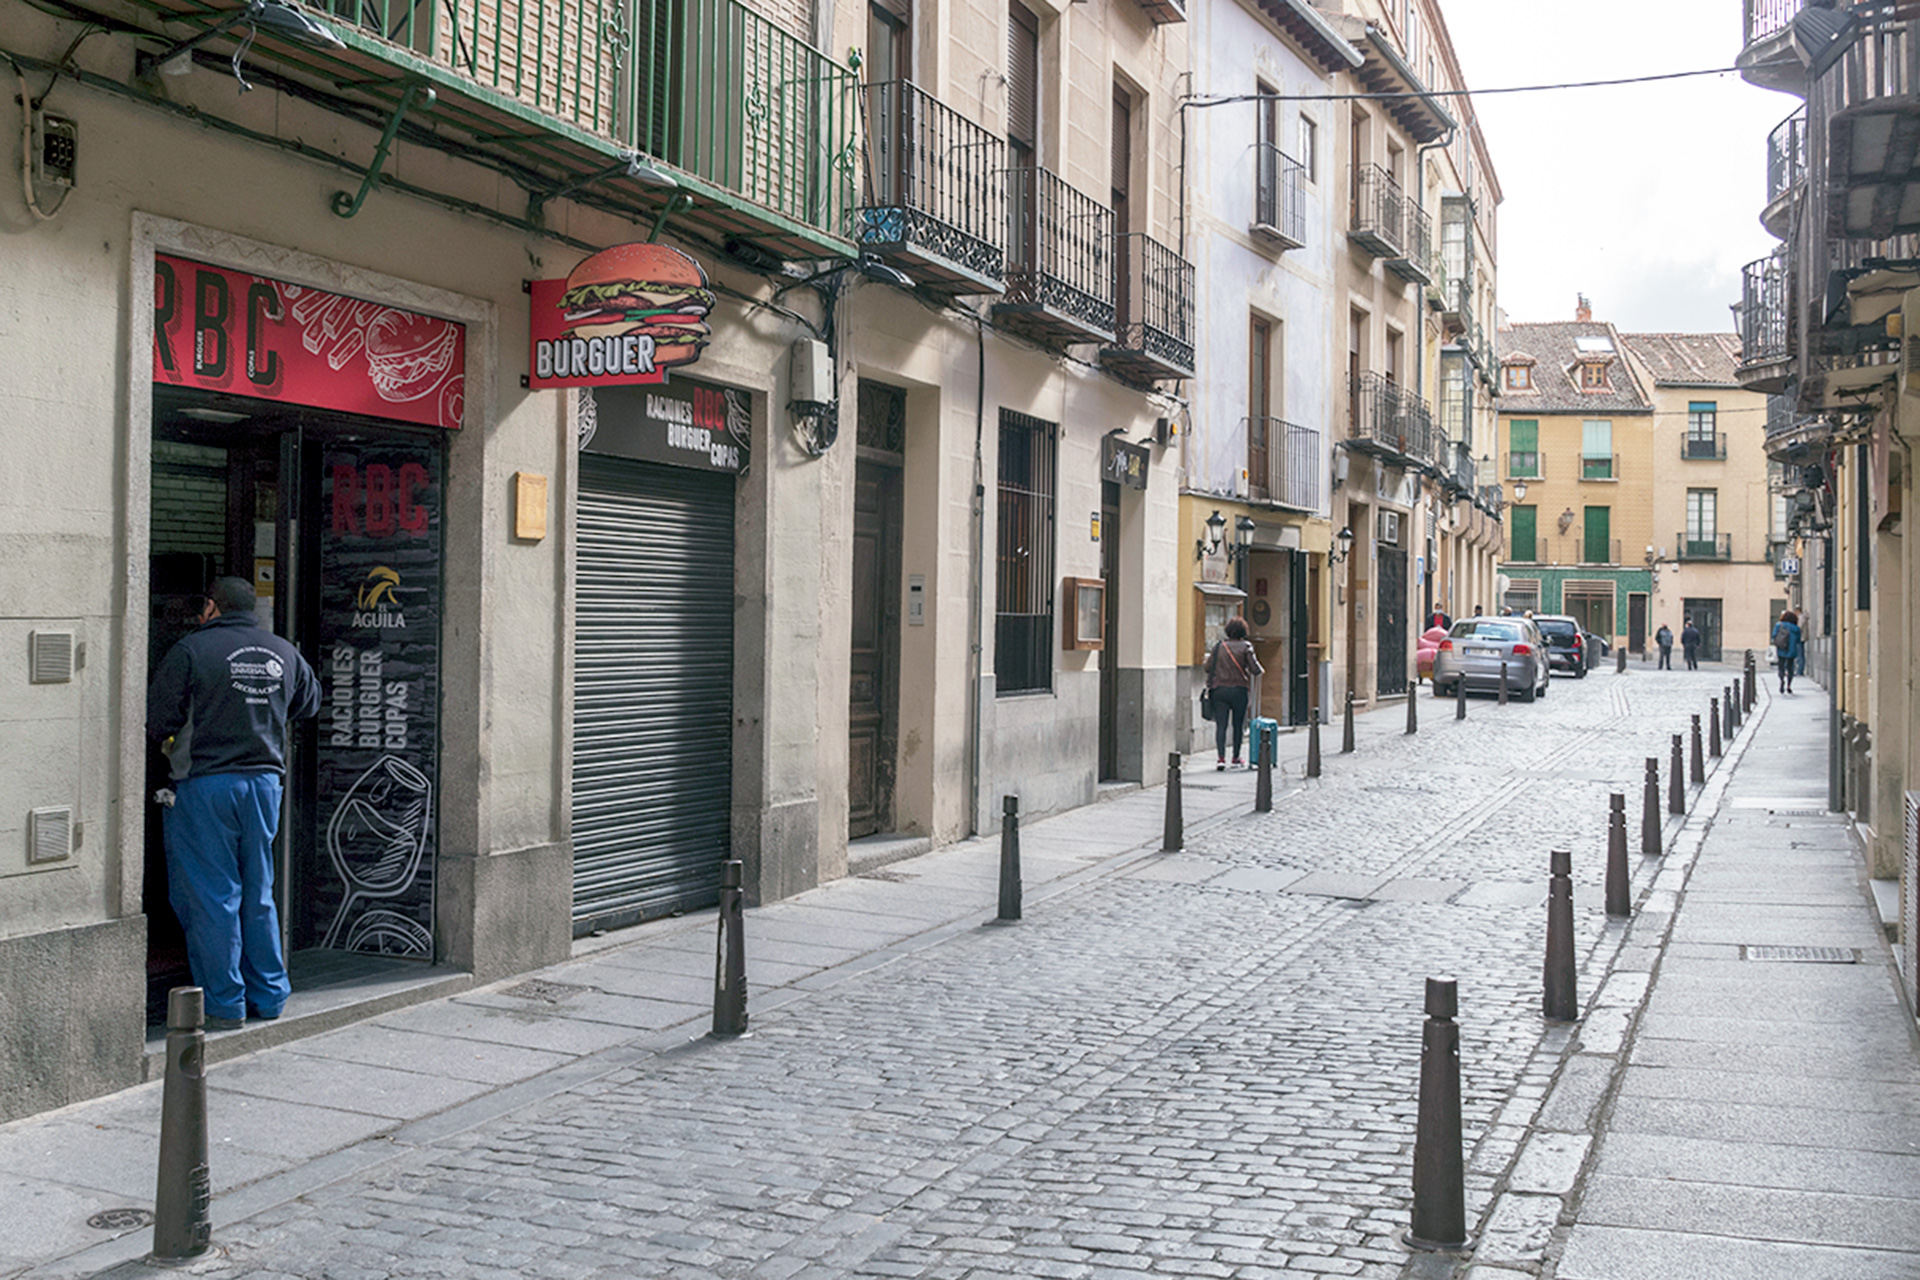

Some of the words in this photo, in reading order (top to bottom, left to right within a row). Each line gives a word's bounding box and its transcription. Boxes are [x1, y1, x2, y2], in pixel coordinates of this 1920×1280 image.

[196, 331, 204, 370] BURGUER
[247, 350, 256, 378] COPAS
[535, 335, 656, 379] BURGUER
[646, 393, 693, 425] RACIONES
[693, 387, 725, 431] RBC
[667, 423, 712, 453] BURGUER
[710, 443, 740, 469] COPAS
[332, 463, 427, 535] RBC
[331, 646, 355, 747] RACIONES
[359, 650, 383, 748] BURGUER
[385, 681, 408, 749] COPAS
